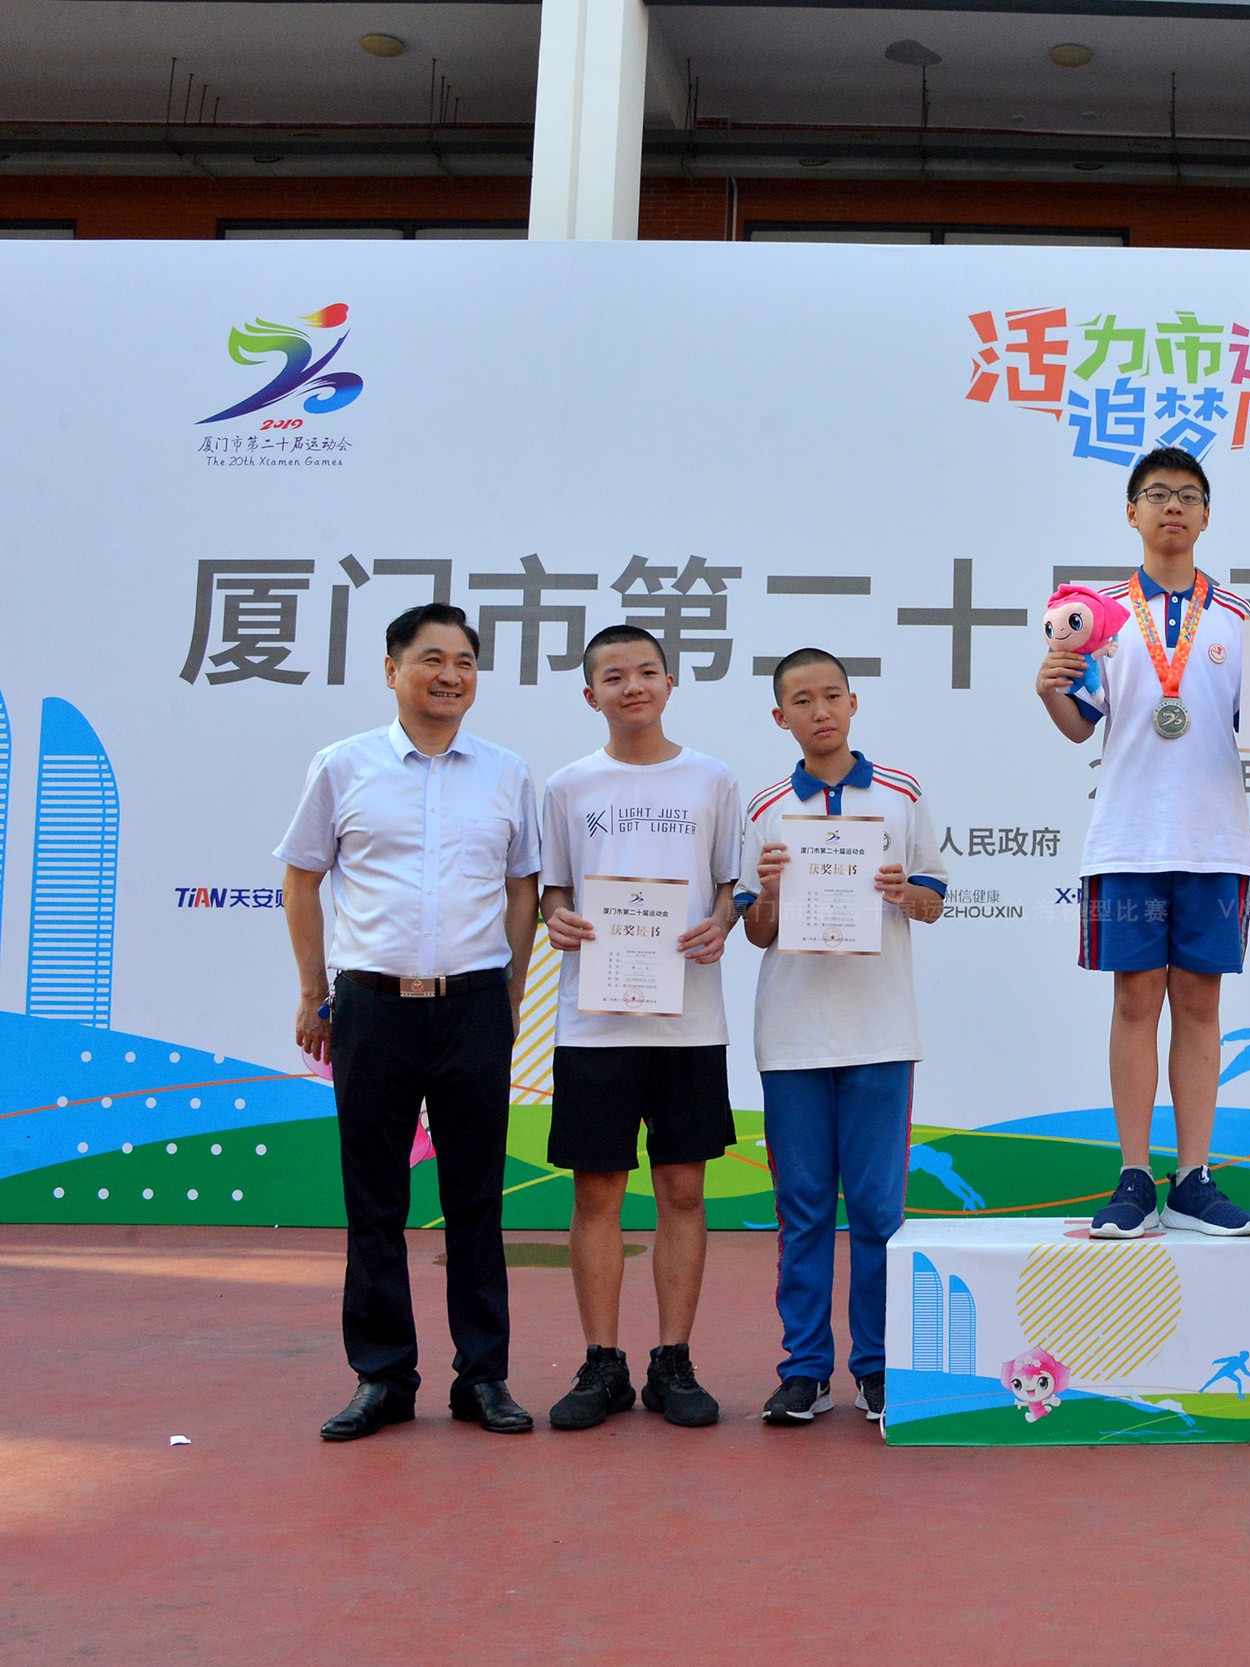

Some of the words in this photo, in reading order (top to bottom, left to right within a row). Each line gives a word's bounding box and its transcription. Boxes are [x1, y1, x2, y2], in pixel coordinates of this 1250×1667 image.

[259, 419, 304, 430] 2019
[198, 436, 353, 453] 厦门市第二十届运动会
[206, 456, 226, 466] The
[228, 456, 255, 466] 20th
[304, 456, 343, 467] Games
[618, 807, 652, 819] LIGHT
[658, 808, 689, 820] JUST
[619, 821, 641, 833] GOT
[650, 822, 697, 836] LIGHTER
[809, 863, 857, 876] 获奖证书
[611, 924, 661, 938] 获奖证书
